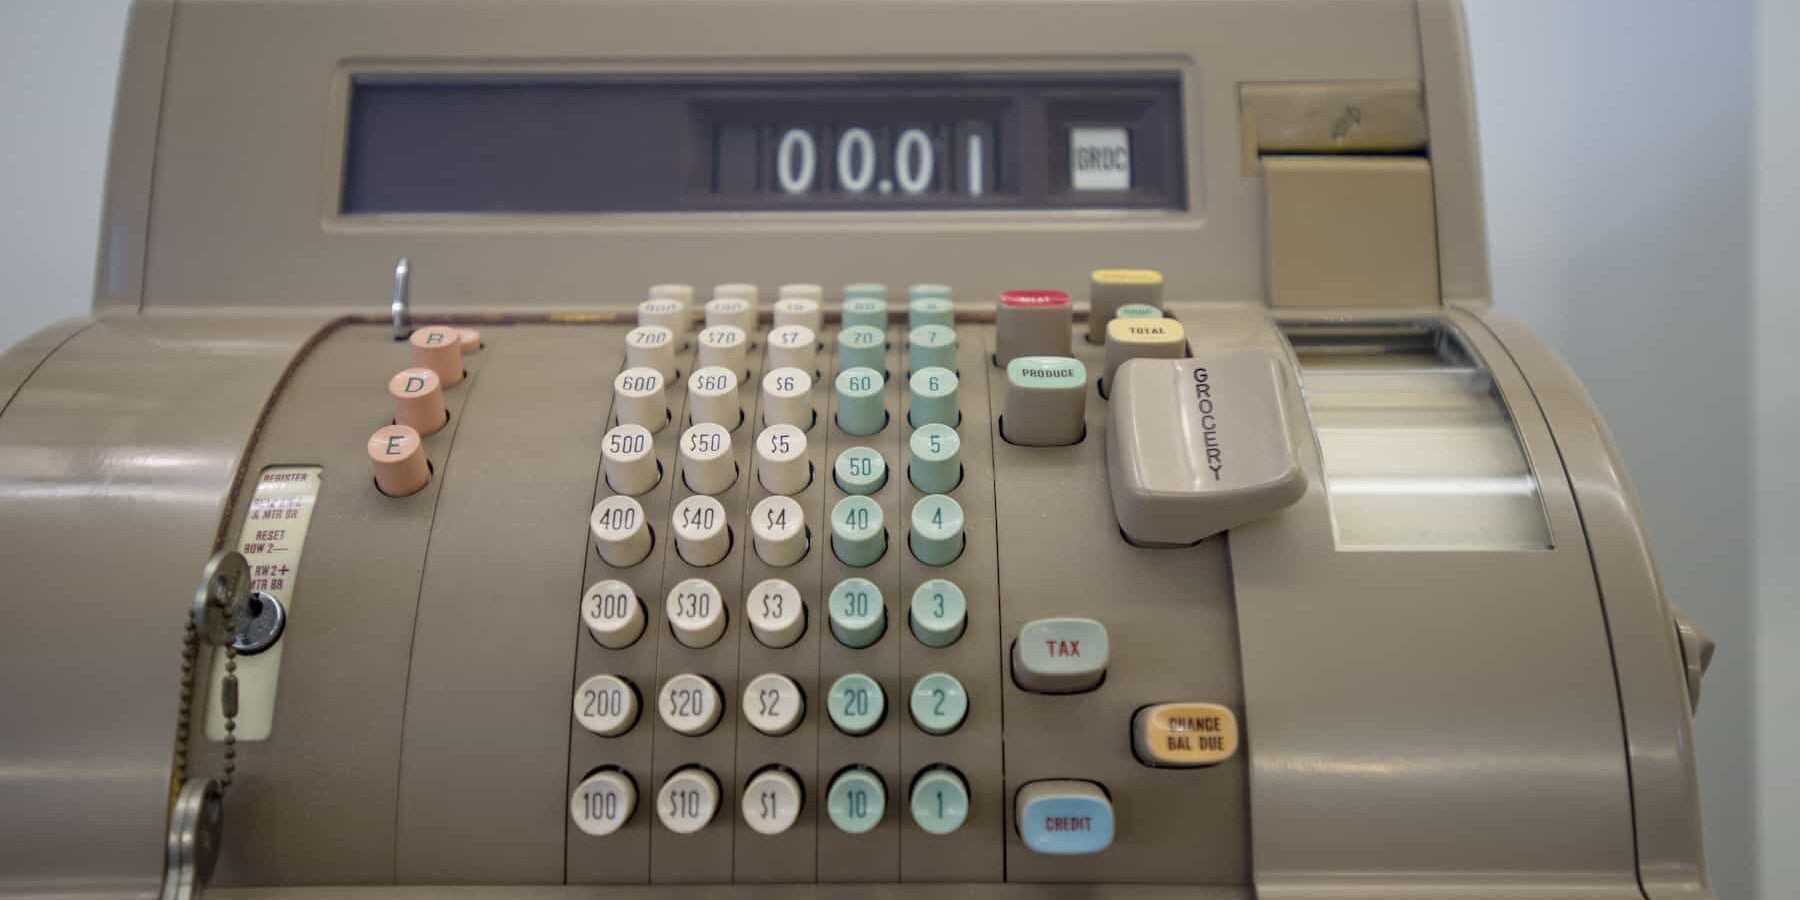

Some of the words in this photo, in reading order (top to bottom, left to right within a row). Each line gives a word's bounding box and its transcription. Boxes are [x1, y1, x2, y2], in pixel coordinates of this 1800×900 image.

[635, 332, 667, 344] 700
[708, 332, 736, 344] $70
[782, 332, 799, 344] $7
[854, 332, 873, 344] 70
[927, 331, 937, 343] 7
[1128, 327, 1166, 335] TOTAL
[697, 375, 727, 390] $60
[1022, 368, 1074, 379] PRODUCE
[405, 377, 425, 393] D
[623, 376, 656, 391] 600
[776, 376, 795, 391] $6
[849, 376, 871, 391] 60
[928, 376, 939, 391] 6
[1193, 368, 1223, 481] GROCERY
[386, 435, 405, 455] E
[610, 434, 644, 454] 500
[690, 433, 721, 452] $50
[771, 434, 790, 453] $5
[929, 434, 941, 453] 5
[849, 457, 872, 476] 50
[599, 508, 635, 530] 400
[682, 507, 714, 529] $40
[767, 508, 786, 530] $4
[845, 508, 868, 530] 40
[932, 507, 943, 529] 4
[256, 530, 286, 541] RESET
[244, 543, 265, 554] ROW
[591, 594, 627, 619] 300
[676, 593, 709, 618] $30
[763, 594, 783, 618] $3
[844, 592, 867, 617] 30
[933, 593, 944, 619] 3
[1046, 640, 1080, 657] TAX
[583, 689, 621, 717] 200
[670, 689, 703, 716] $20
[759, 689, 780, 717] $2
[844, 689, 868, 716] 20
[933, 689, 945, 716] 2
[1168, 717, 1222, 732] CHANGE
[1168, 736, 1192, 751] BAL
[1199, 736, 1224, 751] DUE
[583, 792, 616, 820] 100
[669, 790, 699, 818] $10
[760, 791, 777, 819] $1
[847, 790, 867, 818] 10
[936, 792, 944, 819] 1
[1045, 817, 1092, 832] CREDIT
